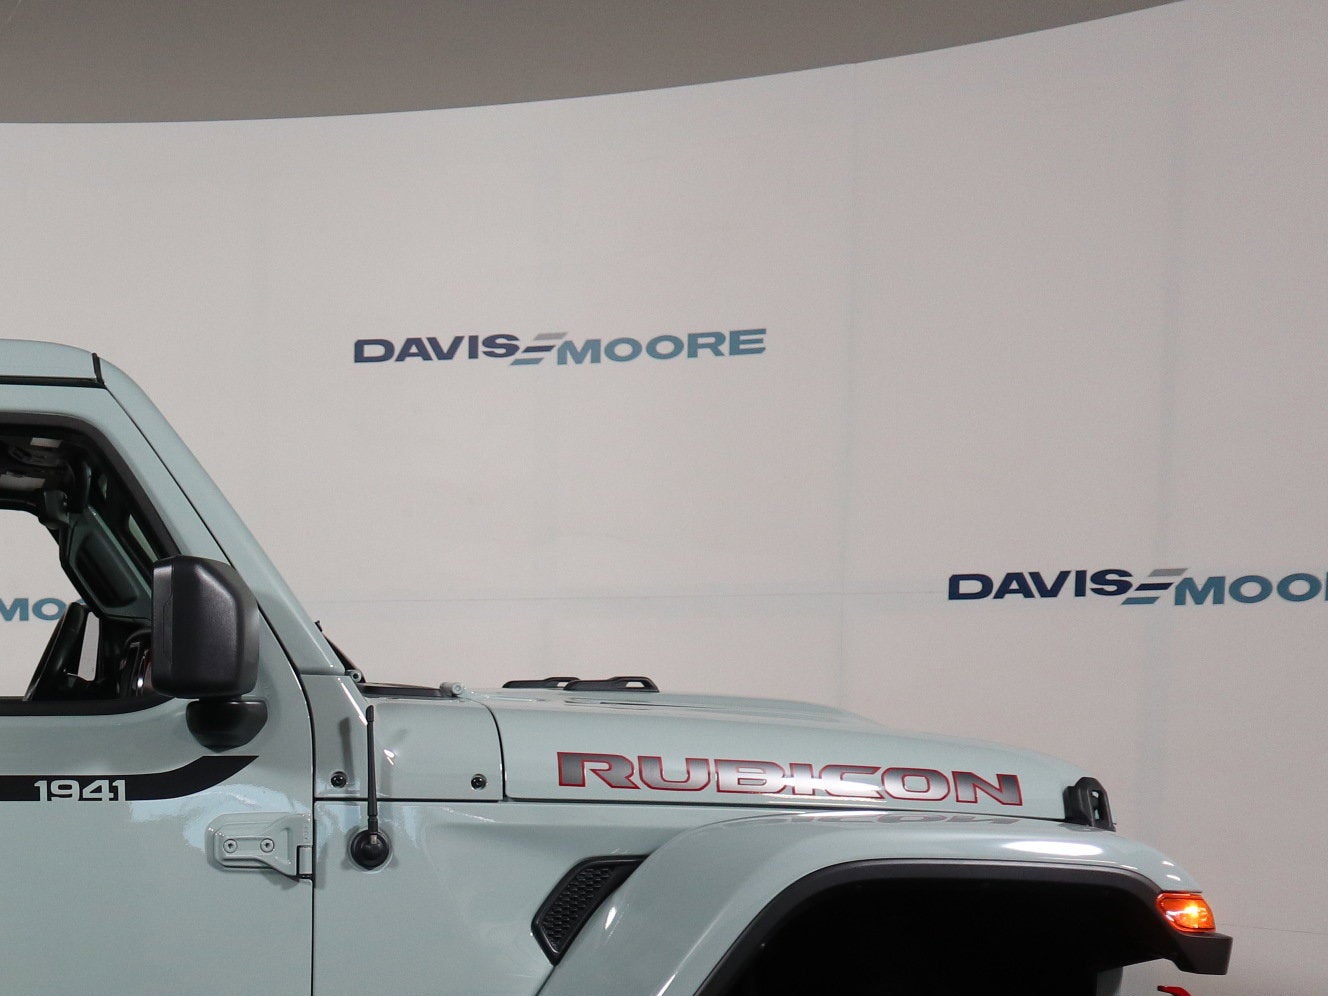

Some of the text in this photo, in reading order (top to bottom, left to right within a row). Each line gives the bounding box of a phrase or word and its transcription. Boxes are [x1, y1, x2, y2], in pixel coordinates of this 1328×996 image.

[354, 328, 767, 366] DAVIS MOORE
[948, 568, 1133, 601] DAVIS
[34, 779, 126, 802] 1941
[557, 751, 1023, 807] RUBICON
